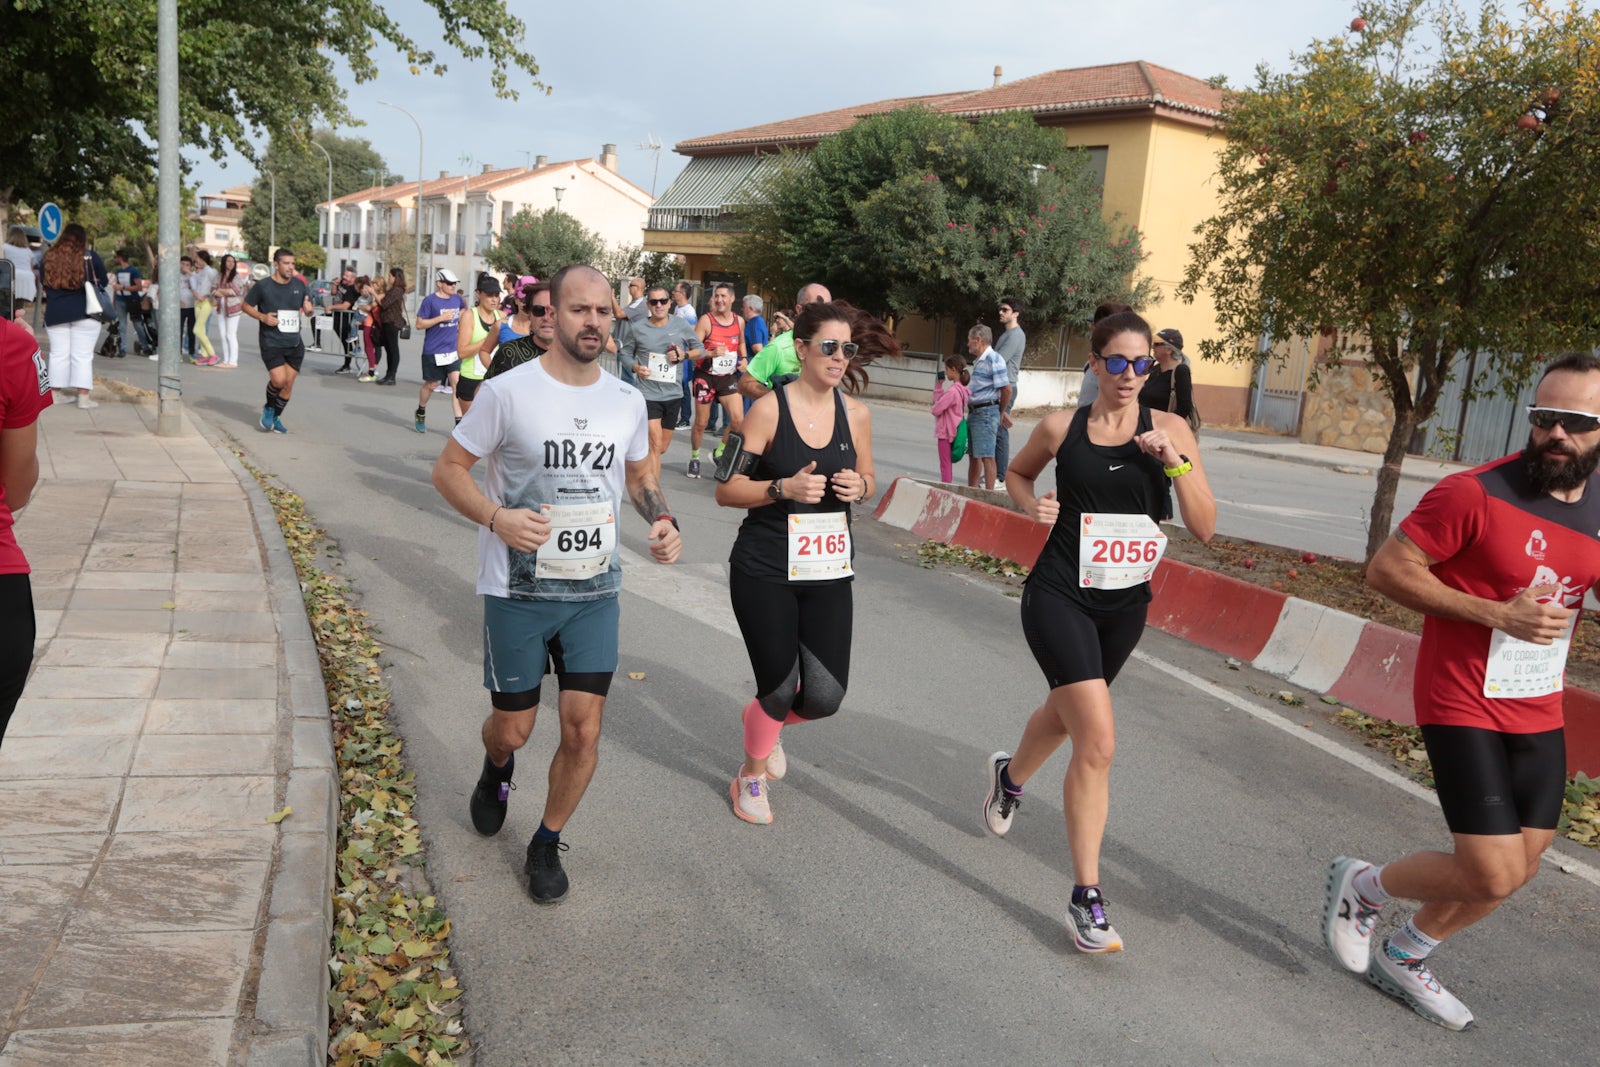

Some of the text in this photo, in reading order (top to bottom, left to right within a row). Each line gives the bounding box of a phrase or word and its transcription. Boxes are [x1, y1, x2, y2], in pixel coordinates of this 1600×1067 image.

[657, 363, 669, 373] 19
[718, 359, 733, 367] 432
[557, 527, 602, 553] 694
[797, 533, 846, 556] 2165
[1091, 539, 1159, 563] 2056
